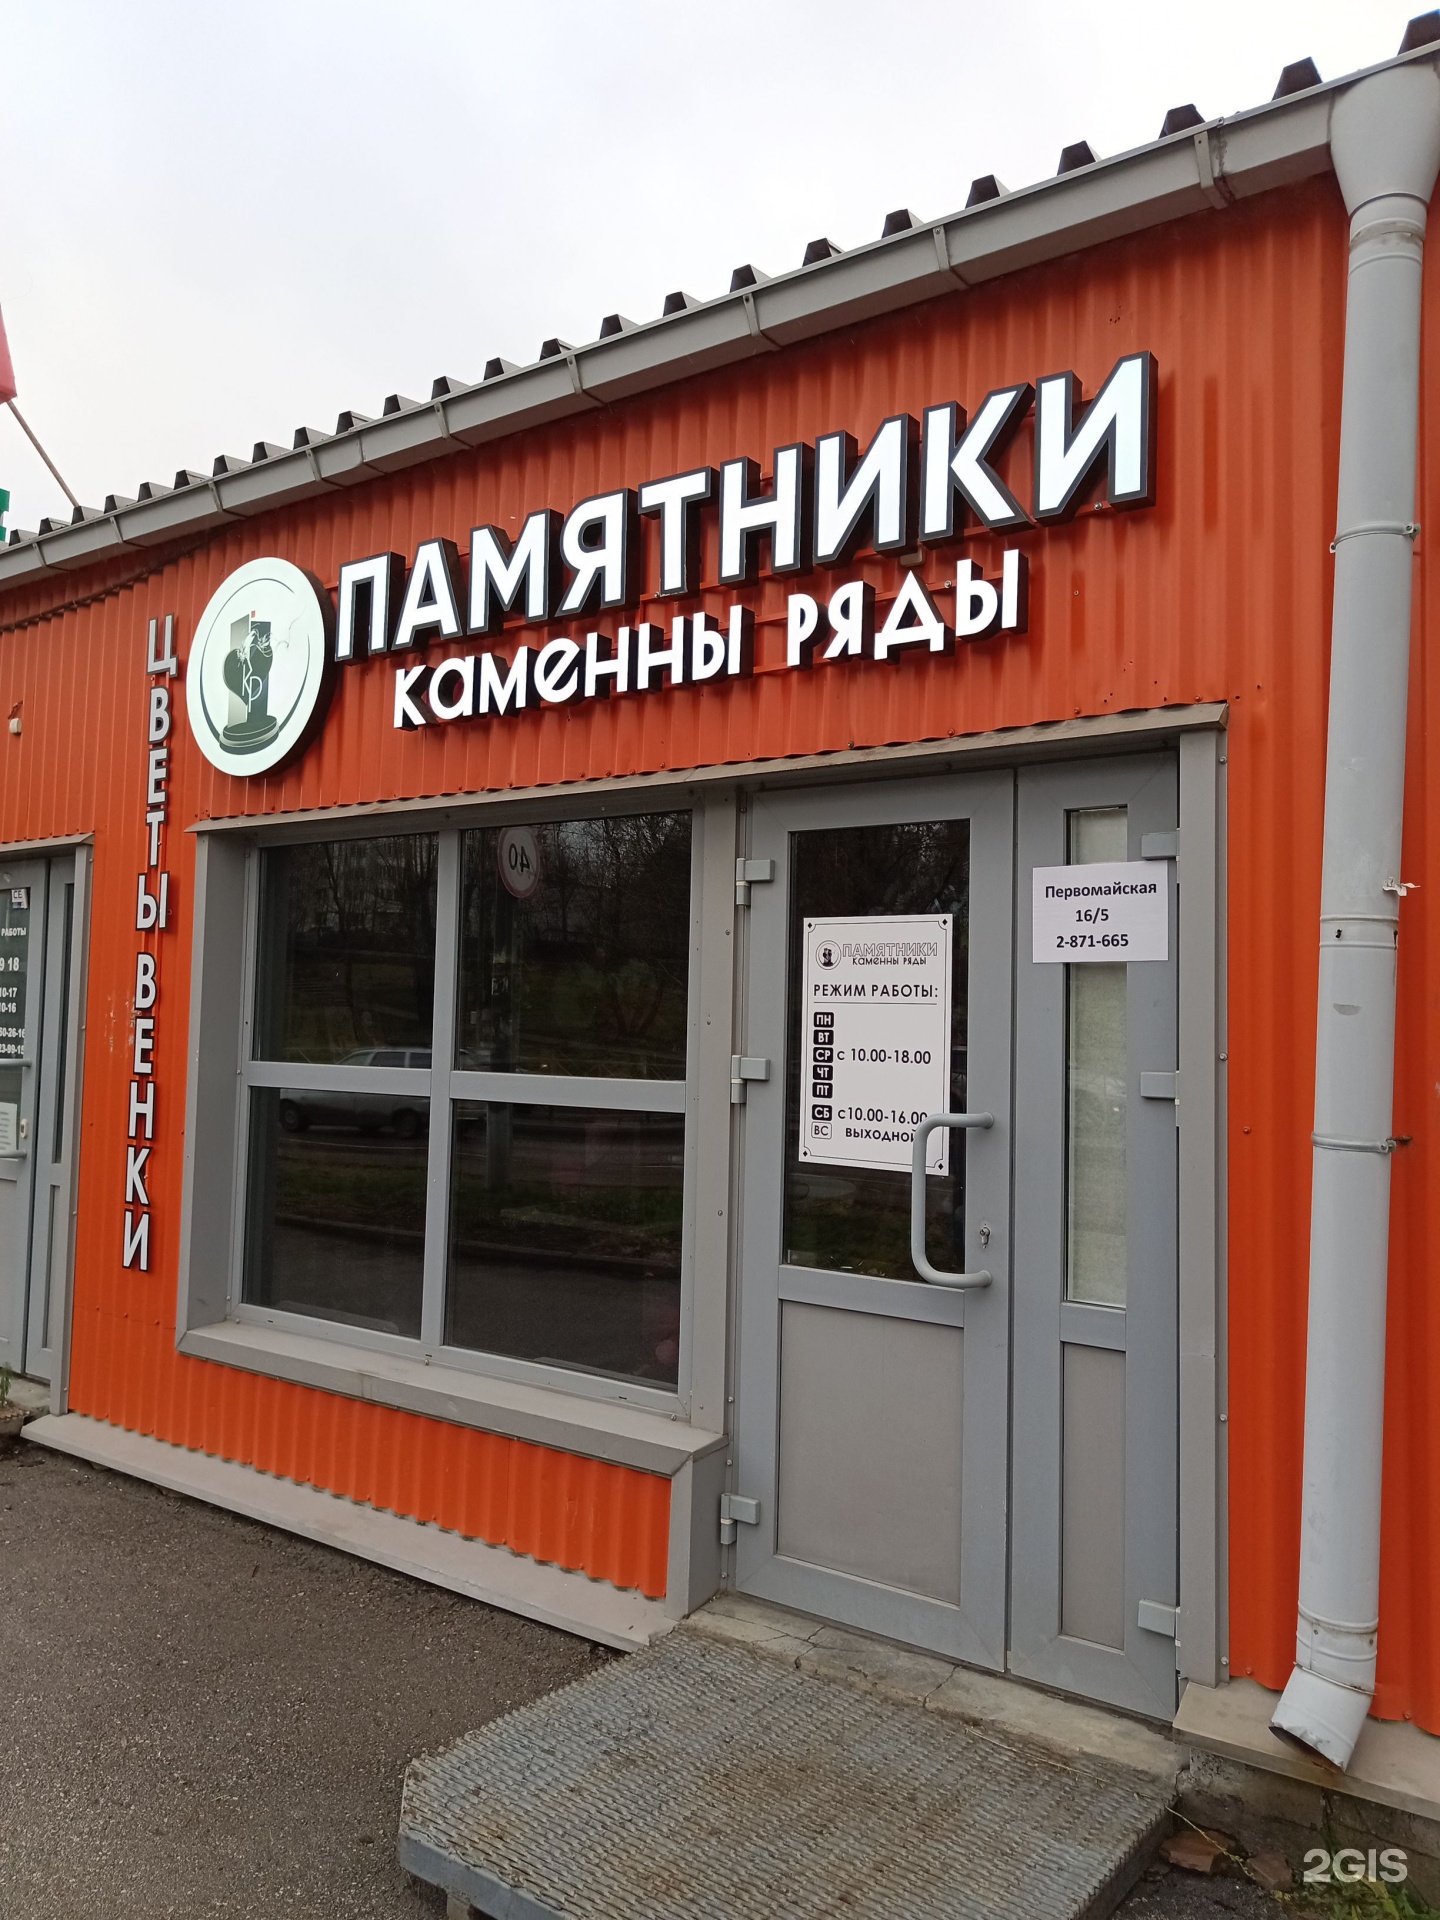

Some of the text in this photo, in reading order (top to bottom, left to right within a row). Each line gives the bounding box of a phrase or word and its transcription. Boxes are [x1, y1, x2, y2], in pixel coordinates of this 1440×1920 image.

[334, 350, 1158, 664] ПАМЯТНИКИ
[1045, 881, 1157, 900] Первомайская
[1075, 908, 1109, 924] 16/5
[1, 927, 27, 936] РАБОТЫ
[122, 612, 178, 1272] ЦВЕТЫ ВЕНКИ
[1056, 934, 1129, 949] 2-871-665
[842, 942, 938, 957] ПАМЯТНИКИ
[7, 957, 20, 971] 18
[813, 984, 938, 998] РЕЖИМ РАБОТЫ:
[816, 1014, 832, 1026] ПН
[818, 1032, 830, 1043] ВТ
[815, 1049, 831, 1061] СР
[851, 1048, 931, 1064] 10.00-18.00
[816, 1067, 830, 1078] ЧТ
[816, 1084, 830, 1096] ПТ
[814, 1107, 830, 1118] СБ
[814, 1125, 829, 1136] ВС
